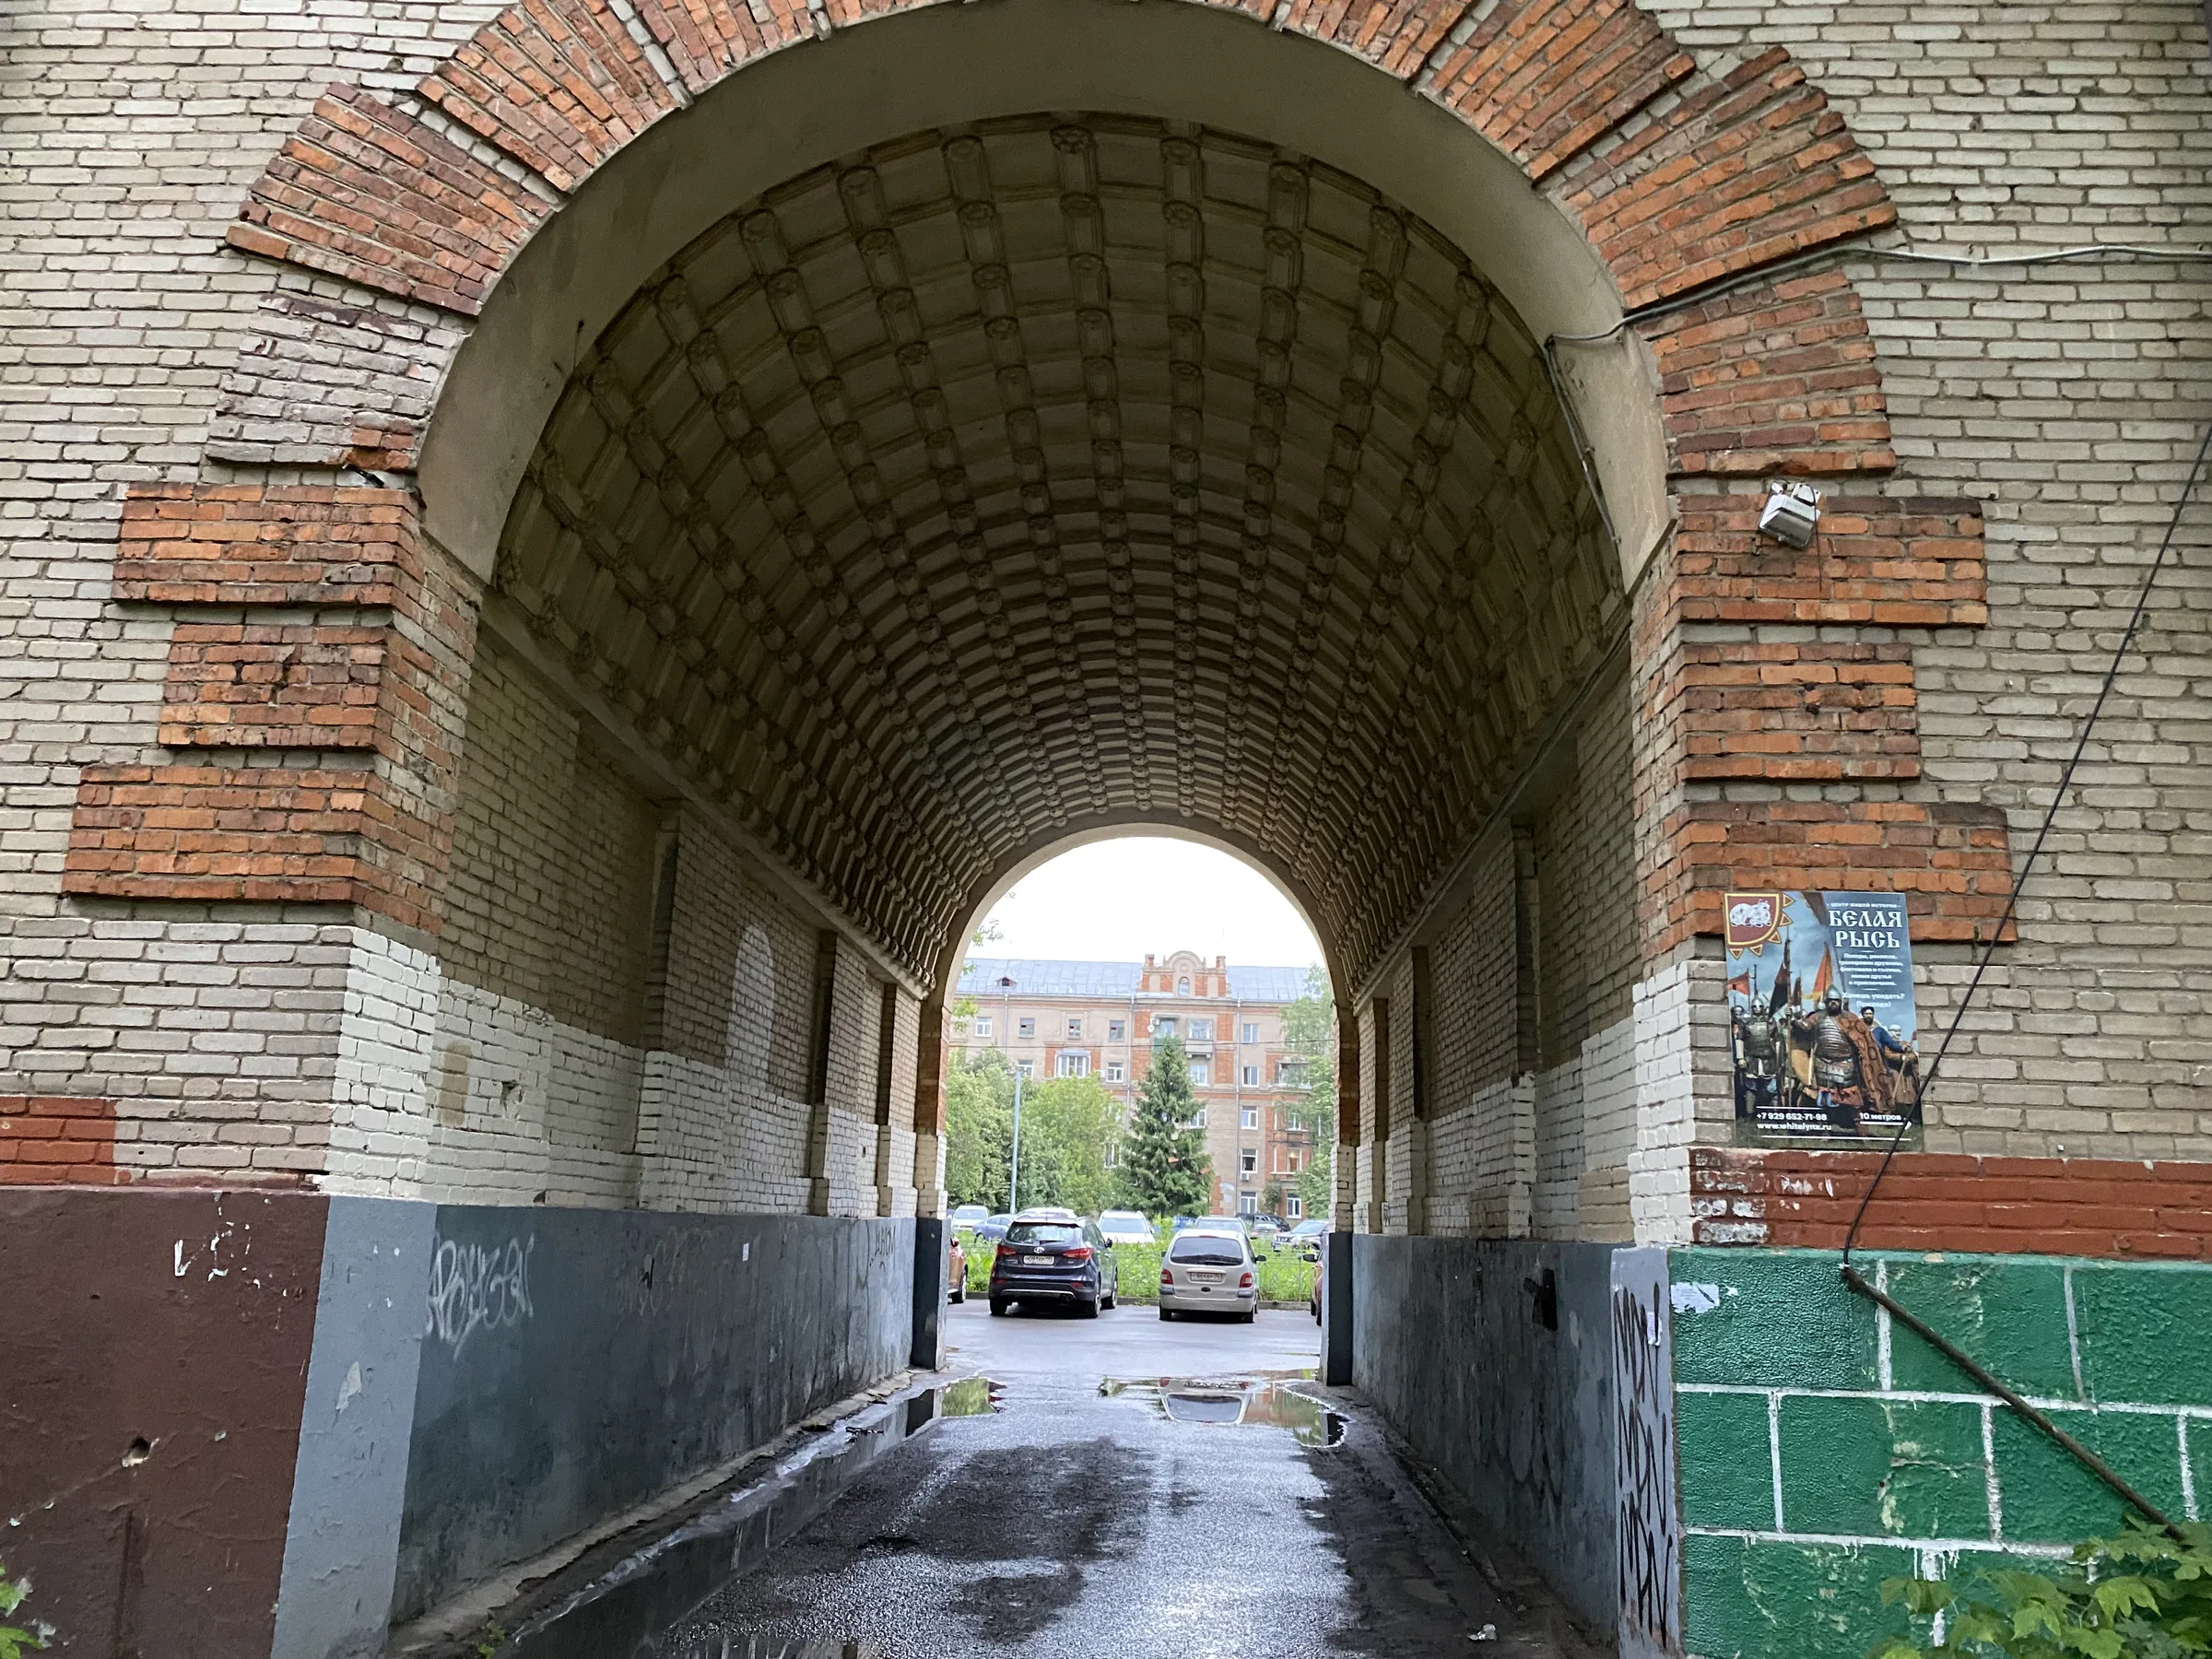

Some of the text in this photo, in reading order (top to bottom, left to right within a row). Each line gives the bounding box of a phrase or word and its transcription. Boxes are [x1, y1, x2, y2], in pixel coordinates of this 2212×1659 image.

[1828, 910, 1903, 927] БЕЛАЯ
[1835, 930, 1900, 948] РЫСЬ
[1785, 1112, 1828, 1121] 652-71-98
[1859, 1112, 1901, 1122] 10 метров
[1757, 1123, 1832, 1132] www.whitelynx.ru
